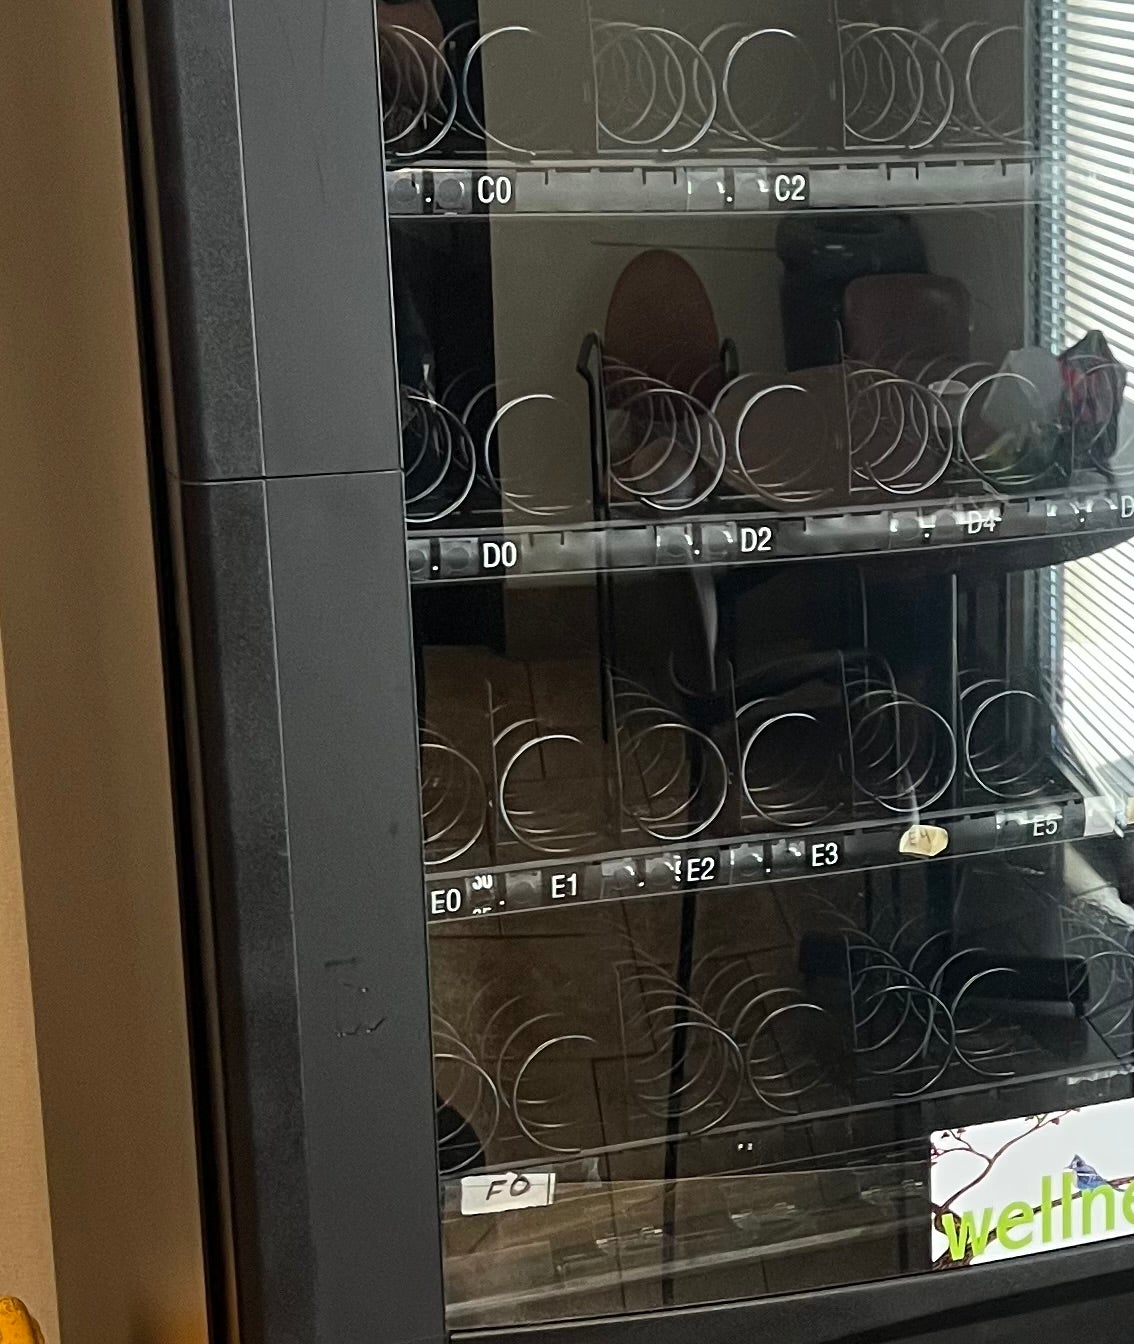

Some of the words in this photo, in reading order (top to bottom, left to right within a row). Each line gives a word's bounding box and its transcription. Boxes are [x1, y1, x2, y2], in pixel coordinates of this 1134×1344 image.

[477, 176, 512, 204] C0
[774, 174, 806, 202] C2
[968, 509, 997, 535] D4
[741, 527, 772, 553] D2
[482, 542, 517, 569] D0
[1032, 817, 1059, 838] E5
[811, 842, 839, 867] E3
[686, 857, 715, 882] E2
[551, 873, 578, 899] E1
[431, 889, 462, 915] E0
